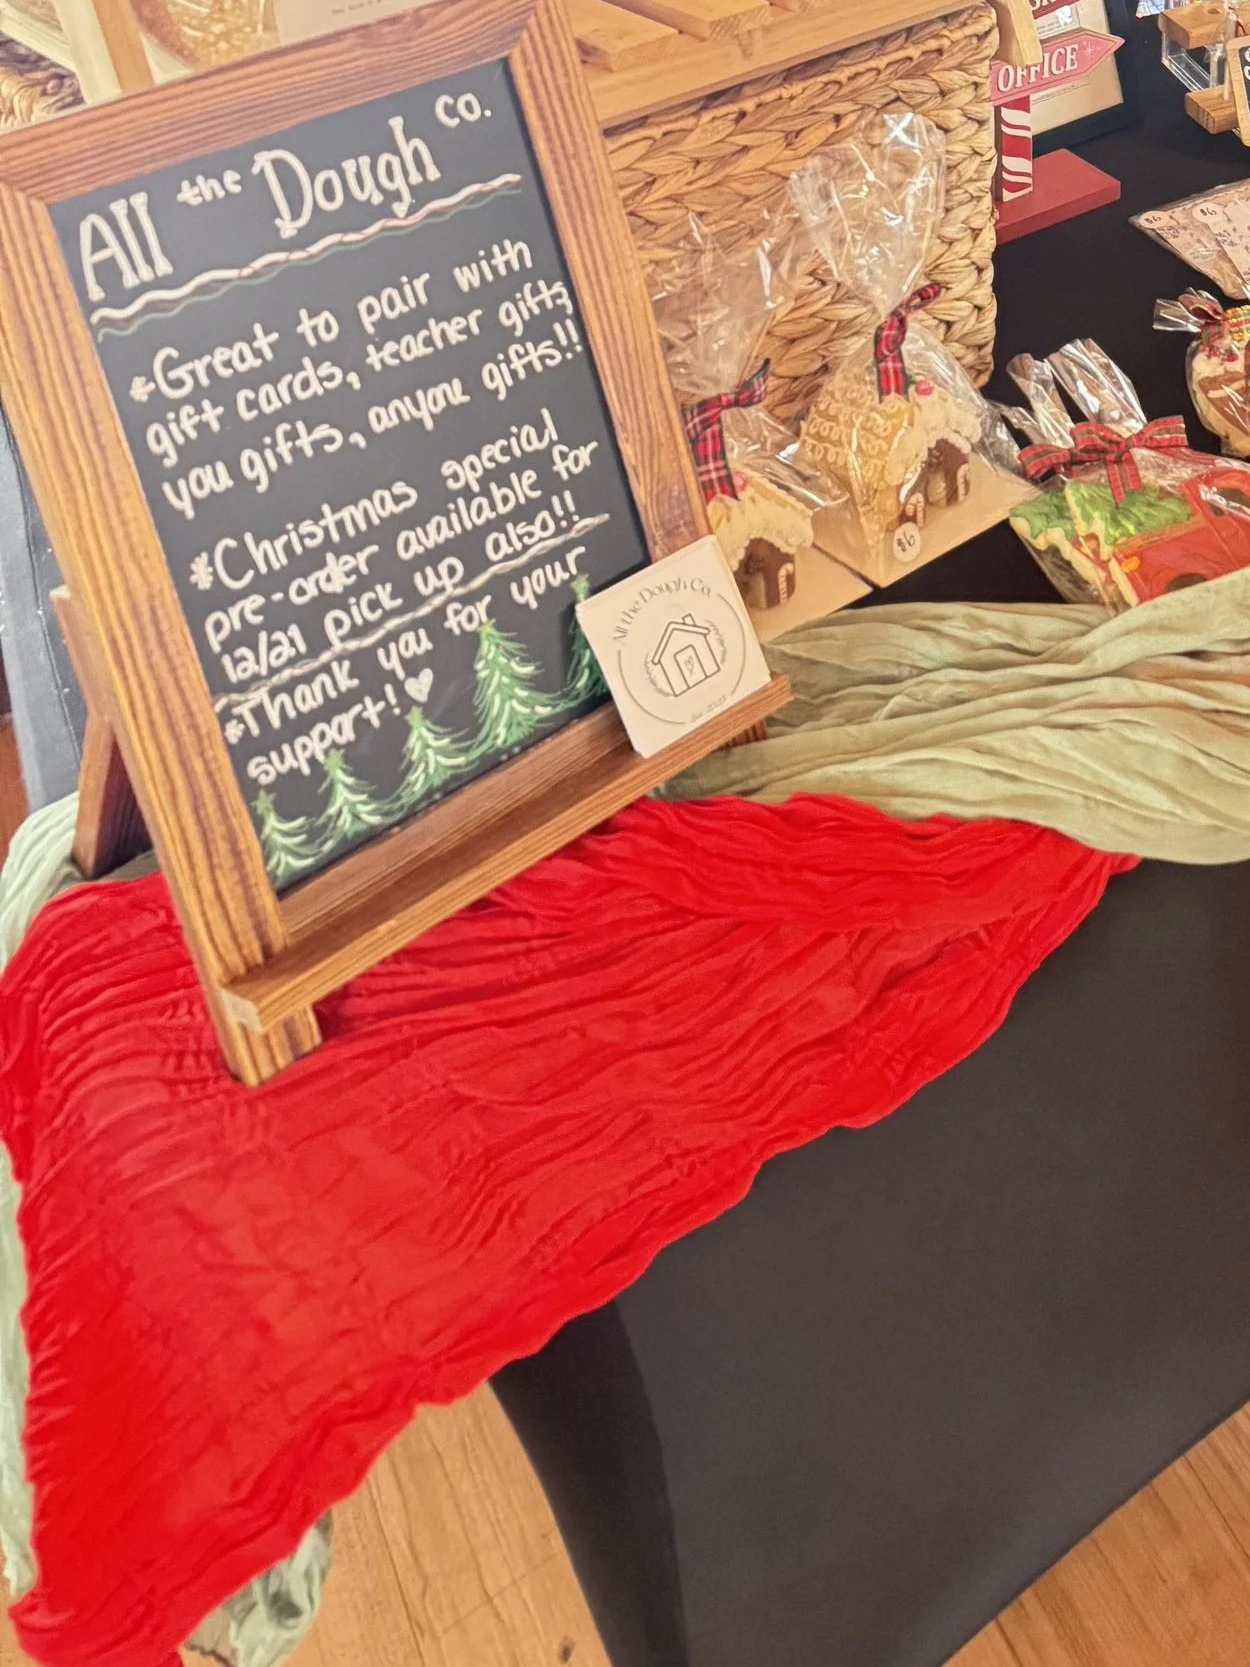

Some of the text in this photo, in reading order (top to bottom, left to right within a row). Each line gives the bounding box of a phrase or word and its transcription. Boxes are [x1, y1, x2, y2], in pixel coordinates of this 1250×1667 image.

[79, 192, 173, 301] All
[176, 170, 242, 206] the
[252, 116, 441, 239] Dough
[297, 308, 339, 347] to
[358, 272, 430, 334] pair
[453, 238, 533, 293] with
[147, 399, 224, 468] gift
[236, 358, 362, 422] cards,
[366, 309, 482, 371] teacher
[162, 462, 233, 519] you
[240, 422, 367, 493] gifts,
[481, 318, 582, 400] gifts!!
[441, 407, 559, 491] special
[206, 441, 598, 653] pre-order available for
[222, 490, 583, 684] 12/21 pick up also!!
[377, 629, 434, 677] you
[444, 595, 493, 637] for
[510, 546, 587, 610] your
[640, 575, 689, 605] Dough
[246, 687, 401, 785] support!
